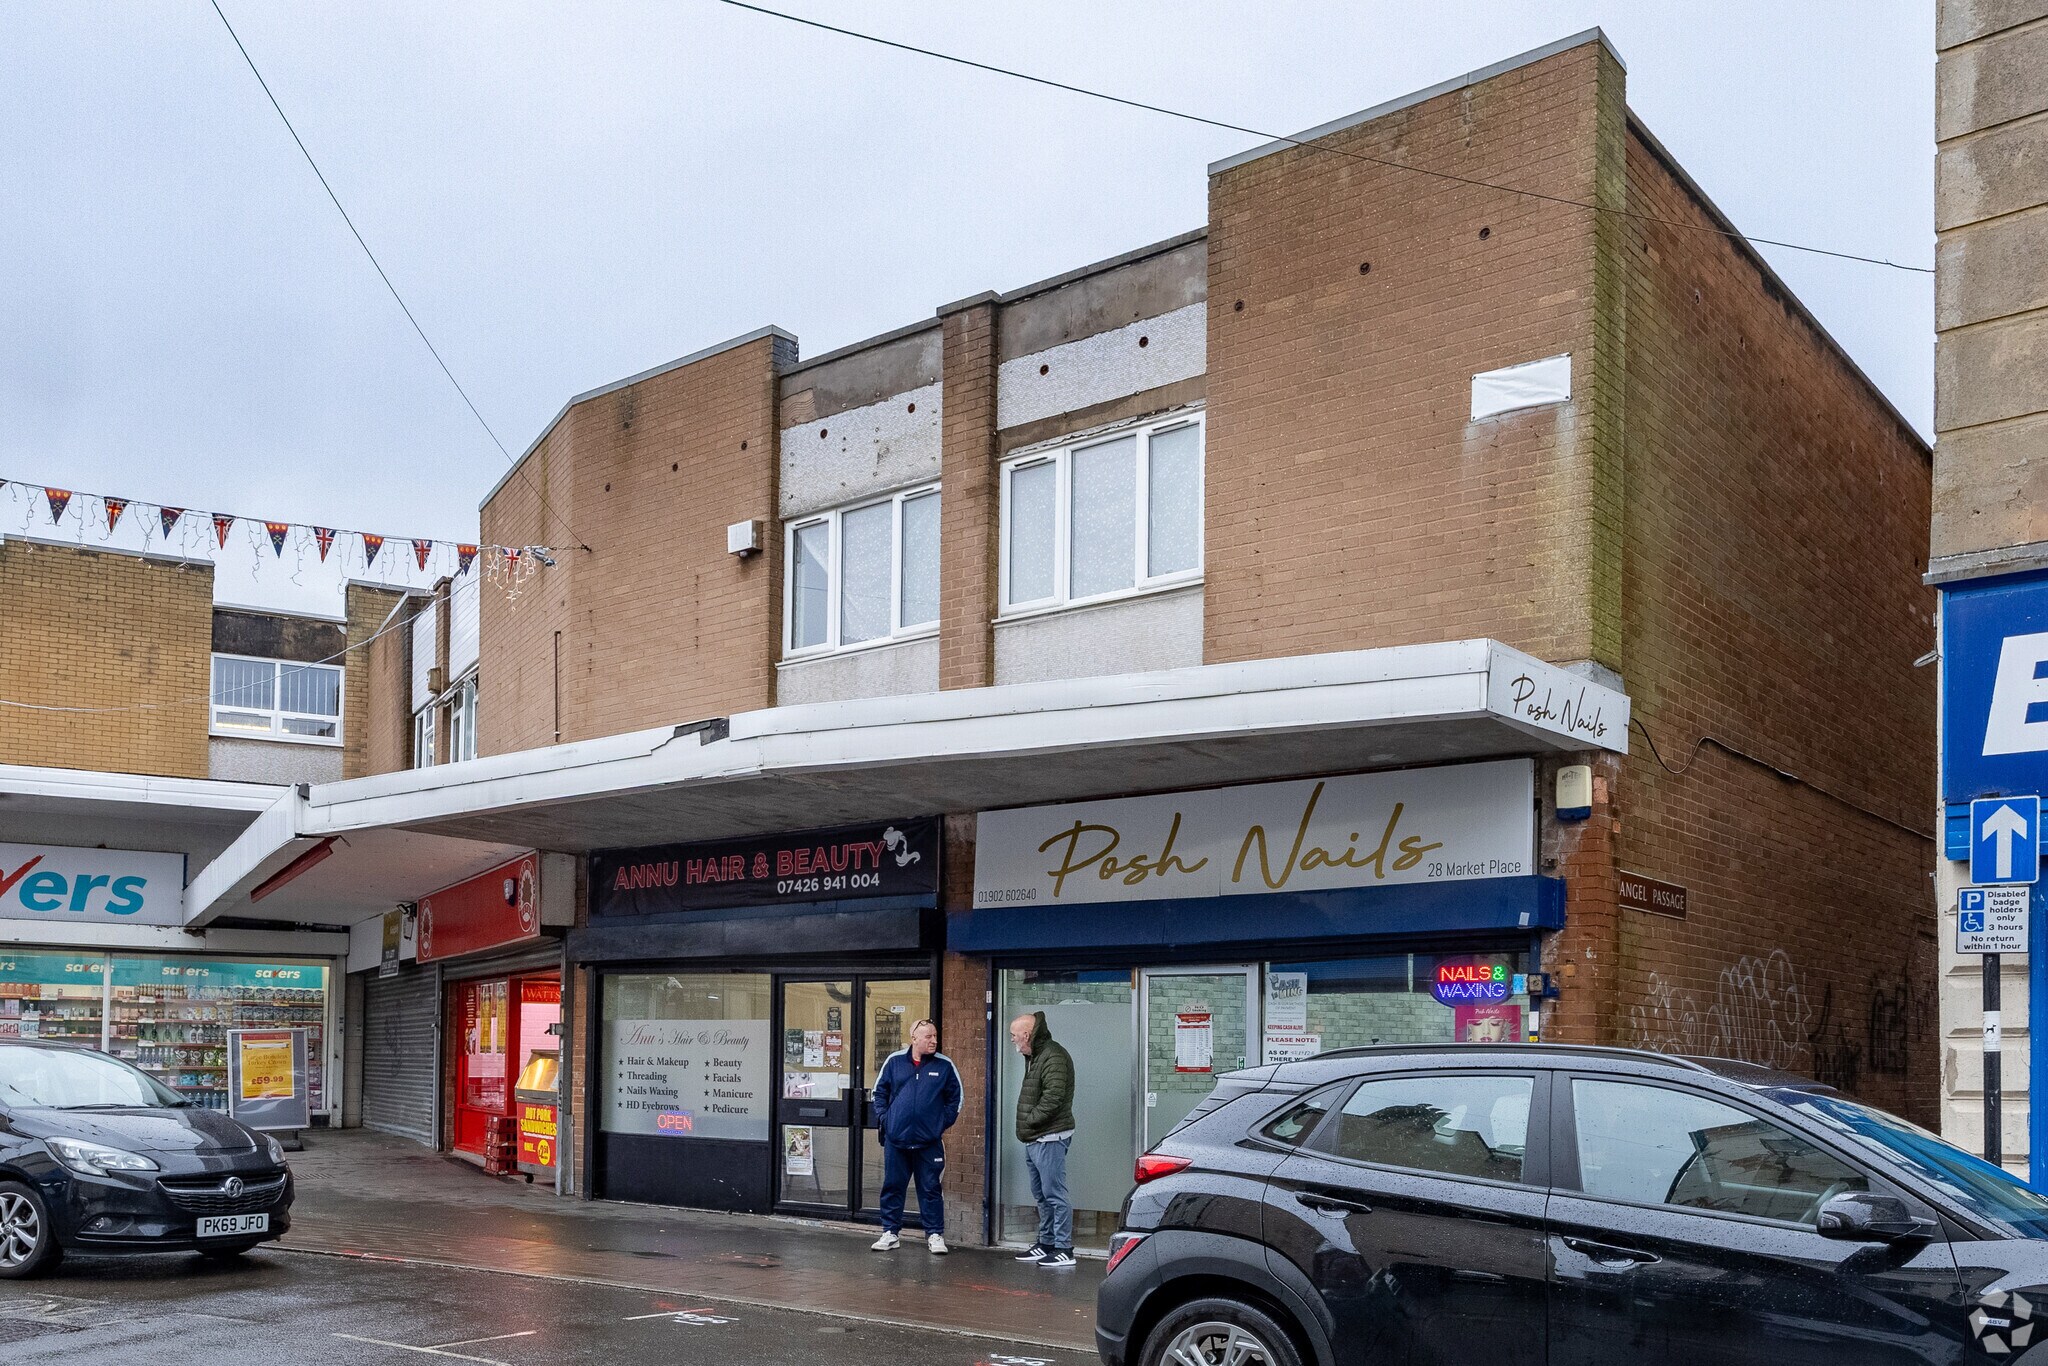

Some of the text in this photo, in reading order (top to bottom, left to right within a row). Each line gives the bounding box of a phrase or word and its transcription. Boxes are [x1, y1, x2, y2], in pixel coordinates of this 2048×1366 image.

[1511, 673, 1607, 739] Posh Nails
[1038, 781, 1443, 898] Posh Nails
[613, 840, 887, 891] ANNU HAIR & BEAUTY
[1428, 859, 1521, 878] 28 Market Place
[777, 873, 880, 894] 07426 941 004
[978, 888, 1037, 903] 01902 602640
[1620, 881, 1685, 910] ANGEL PASSAGE
[1966, 892, 1981, 909] P
[1996, 914, 2016, 922] only
[161, 965, 210, 977] savers
[254, 967, 301, 979] savers
[1440, 966, 1505, 981] NAILS &
[1271, 979, 1300, 990] CASH
[1437, 983, 1506, 998] WAXING
[1279, 987, 1303, 999] KING
[668, 1029, 693, 1046] Hair
[697, 1031, 710, 1046] &
[713, 1029, 750, 1051] Beauty
[627, 1056, 689, 1069] Hair & Makeup
[713, 1058, 743, 1070] Beauty
[251, 1075, 284, 1085] £59.99
[627, 1071, 667, 1084] Threading
[713, 1073, 742, 1083] Facials
[627, 1086, 678, 1099] Nails Waxing
[712, 1088, 753, 1099] Manicure
[626, 1101, 680, 1113] HD Eyebrows
[712, 1103, 749, 1114] Pedicure
[657, 1114, 692, 1130] OPEN
[203, 1217, 238, 1234] PK69
